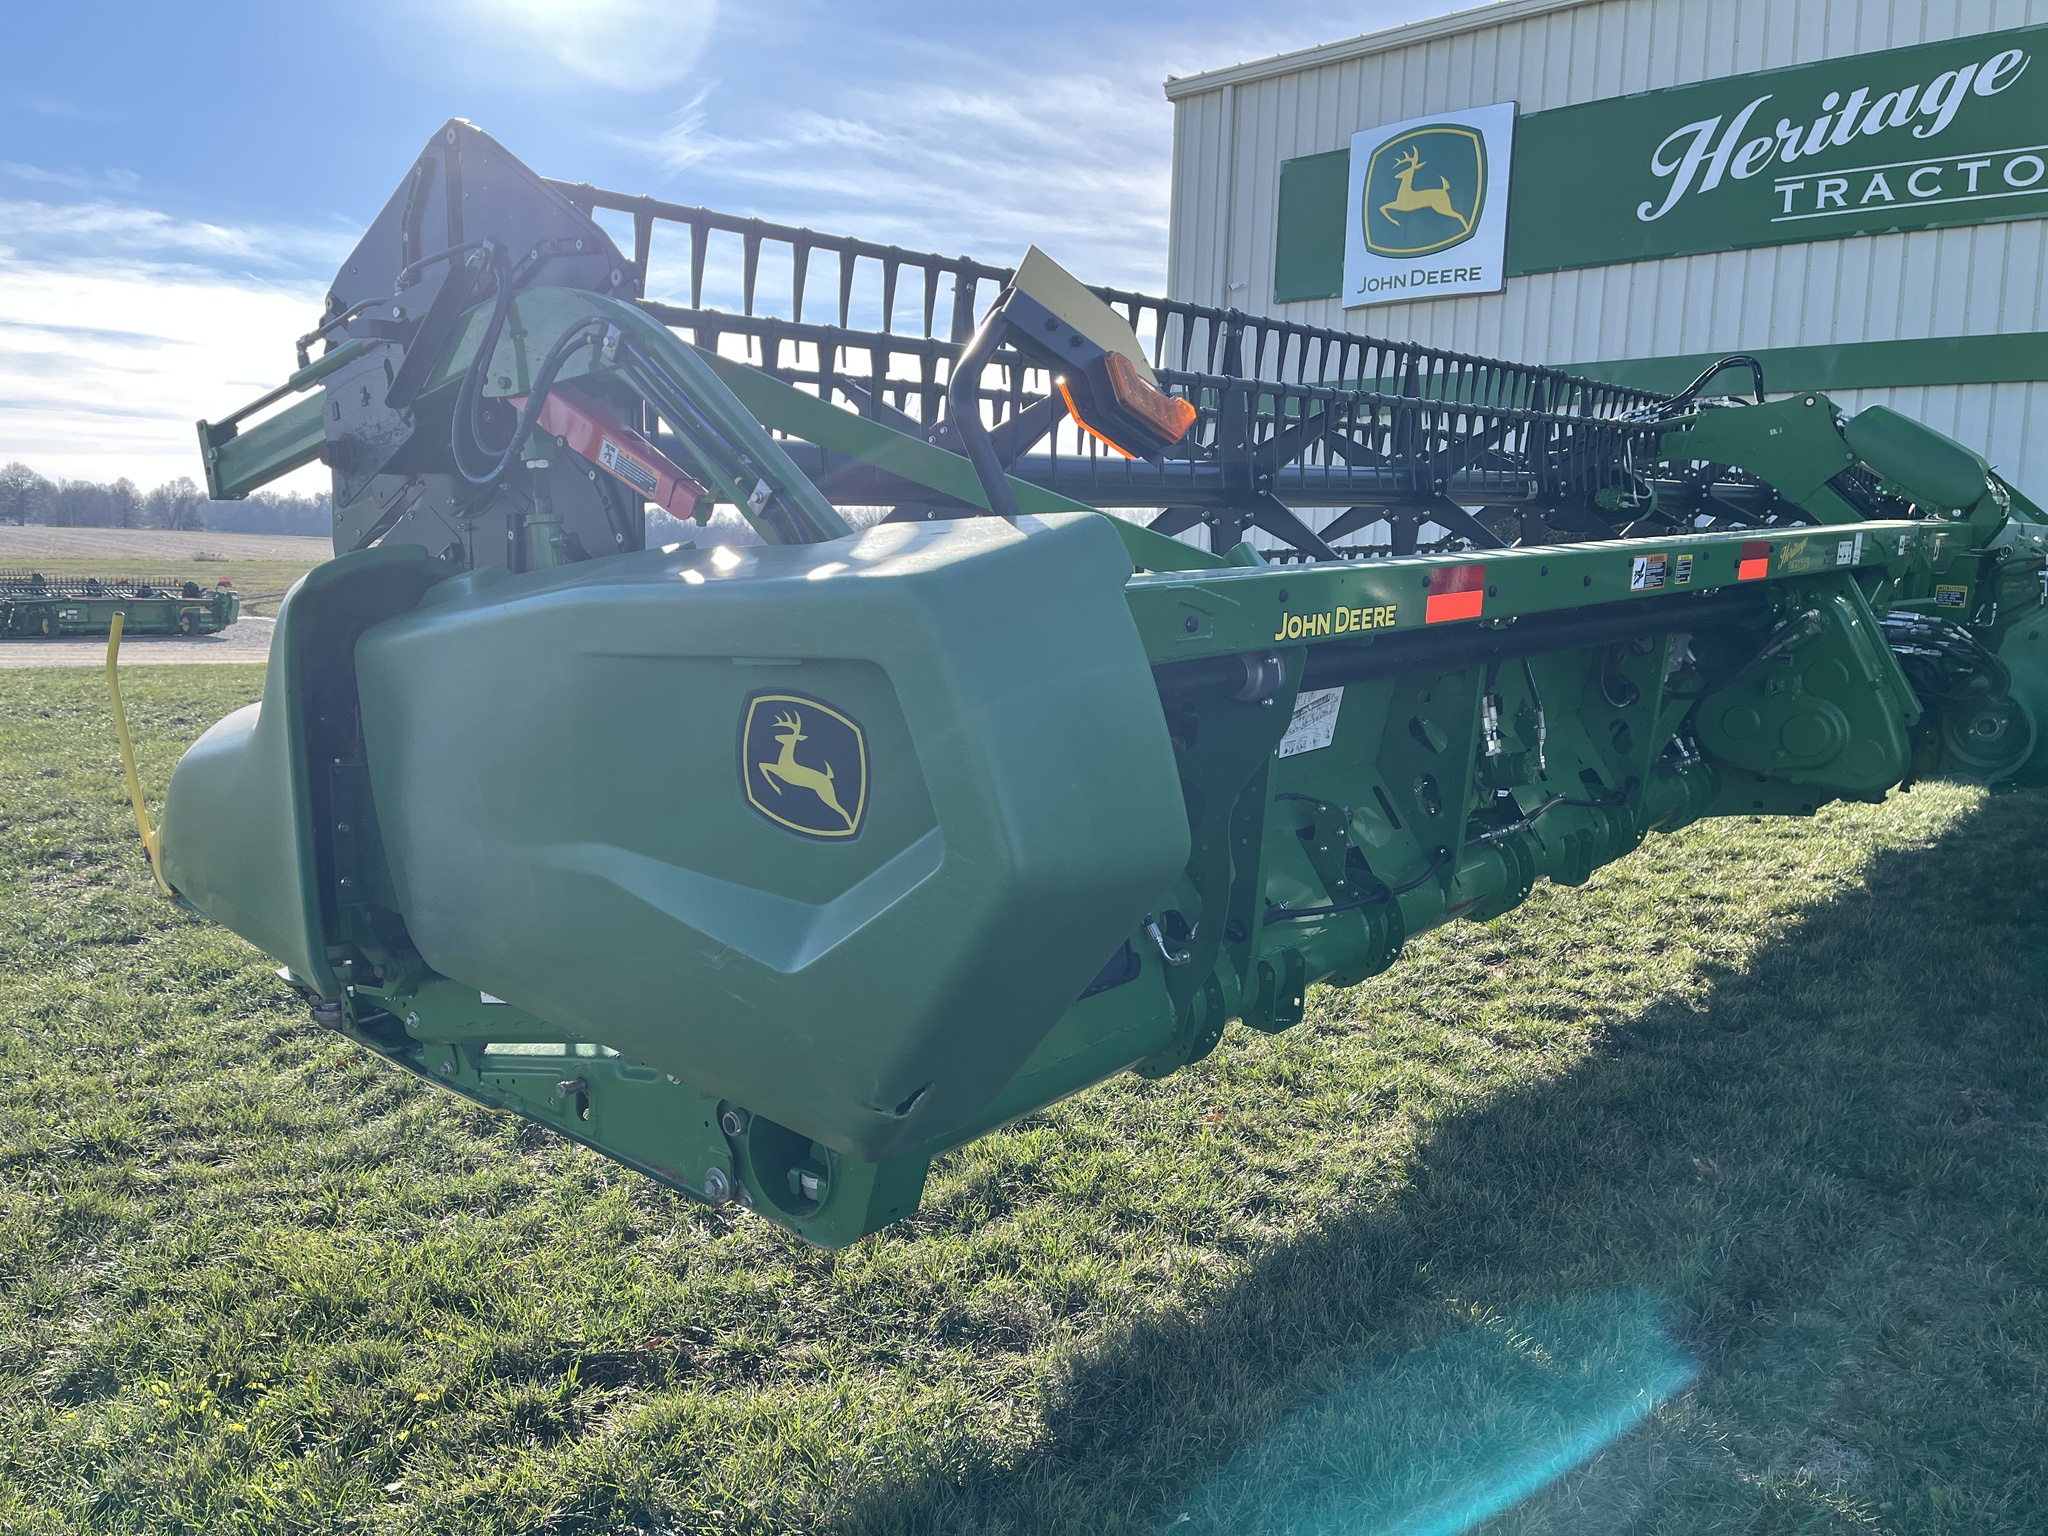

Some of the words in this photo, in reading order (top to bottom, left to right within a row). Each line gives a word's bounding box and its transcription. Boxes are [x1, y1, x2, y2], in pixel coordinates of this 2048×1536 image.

[1637, 49, 2031, 222] Heritage
[1357, 274, 1406, 294] JOHN
[1410, 266, 1482, 287] DEERE
[1274, 611, 1331, 641] JOHN
[1334, 604, 1397, 634] DEERE
